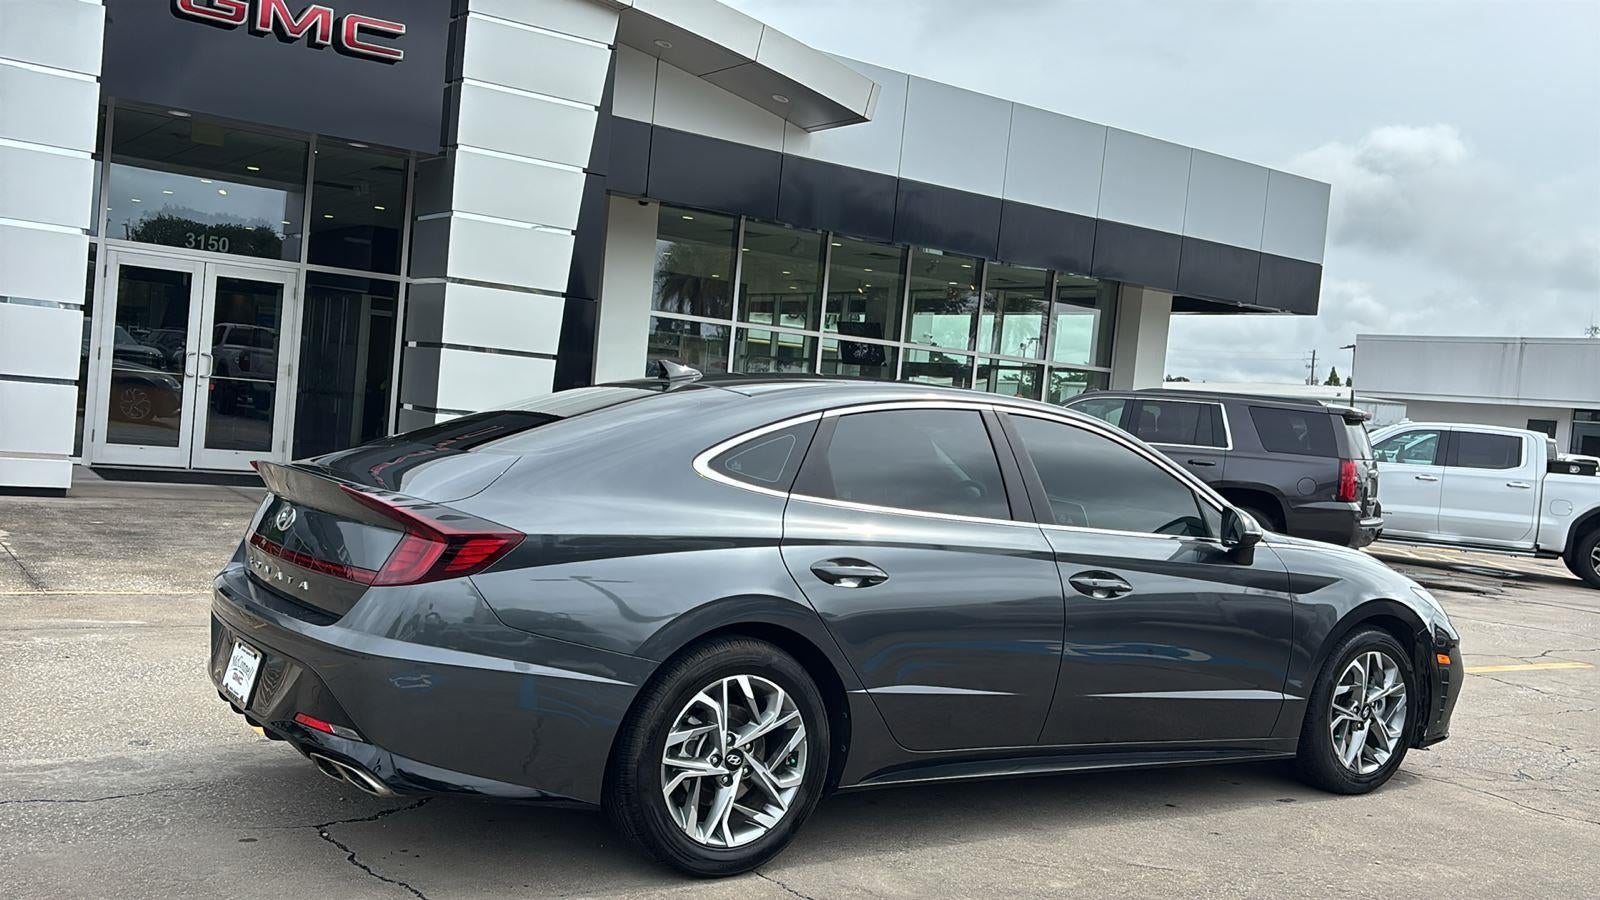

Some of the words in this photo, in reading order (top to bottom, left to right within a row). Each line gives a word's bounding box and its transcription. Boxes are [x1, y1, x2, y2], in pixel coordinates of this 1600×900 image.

[172, 0, 406, 63] GMC
[185, 232, 229, 252] 3150
[249, 556, 309, 591] SONATA
